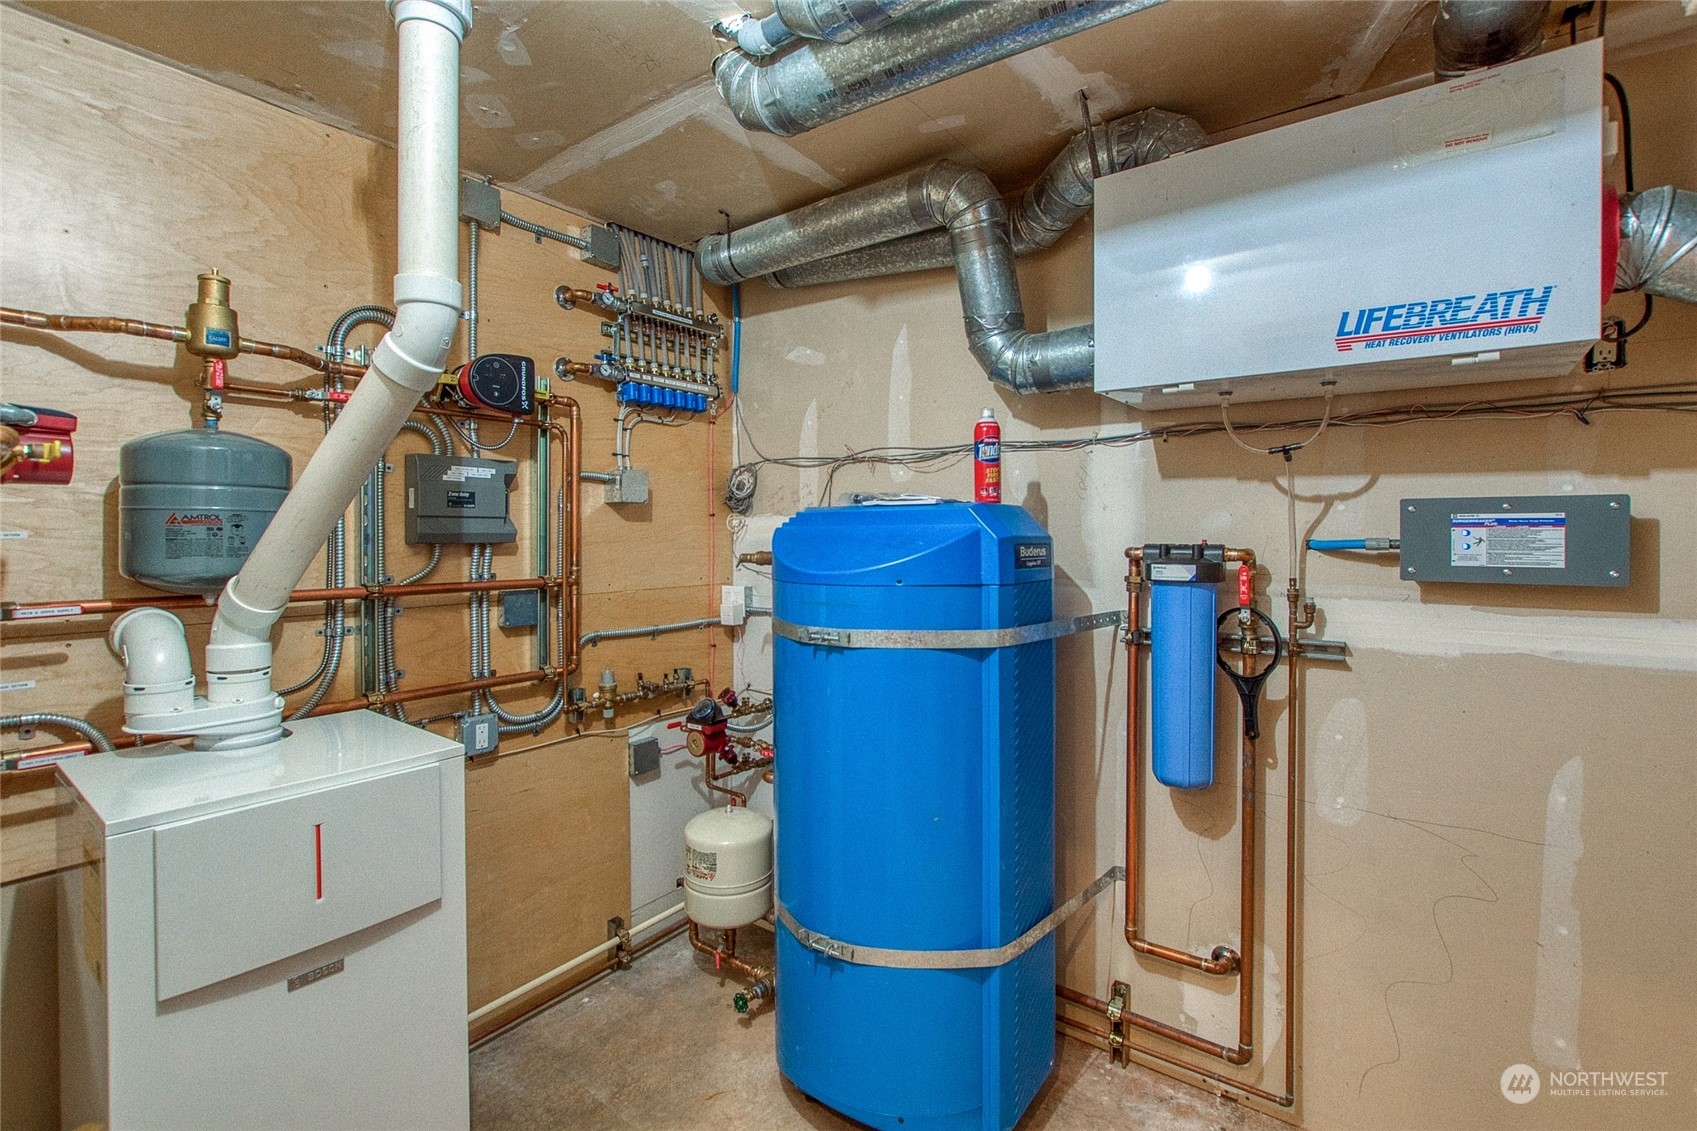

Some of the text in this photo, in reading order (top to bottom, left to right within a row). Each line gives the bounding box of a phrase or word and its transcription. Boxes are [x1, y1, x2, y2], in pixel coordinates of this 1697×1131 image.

[1336, 285, 1553, 337] LIFEBREATH
[1364, 323, 1539, 350] HEAT RECOVERY VENTILATORS (HRVs)
[182, 513, 221, 521] AMTROL
[1020, 546, 1047, 557] Buderus
